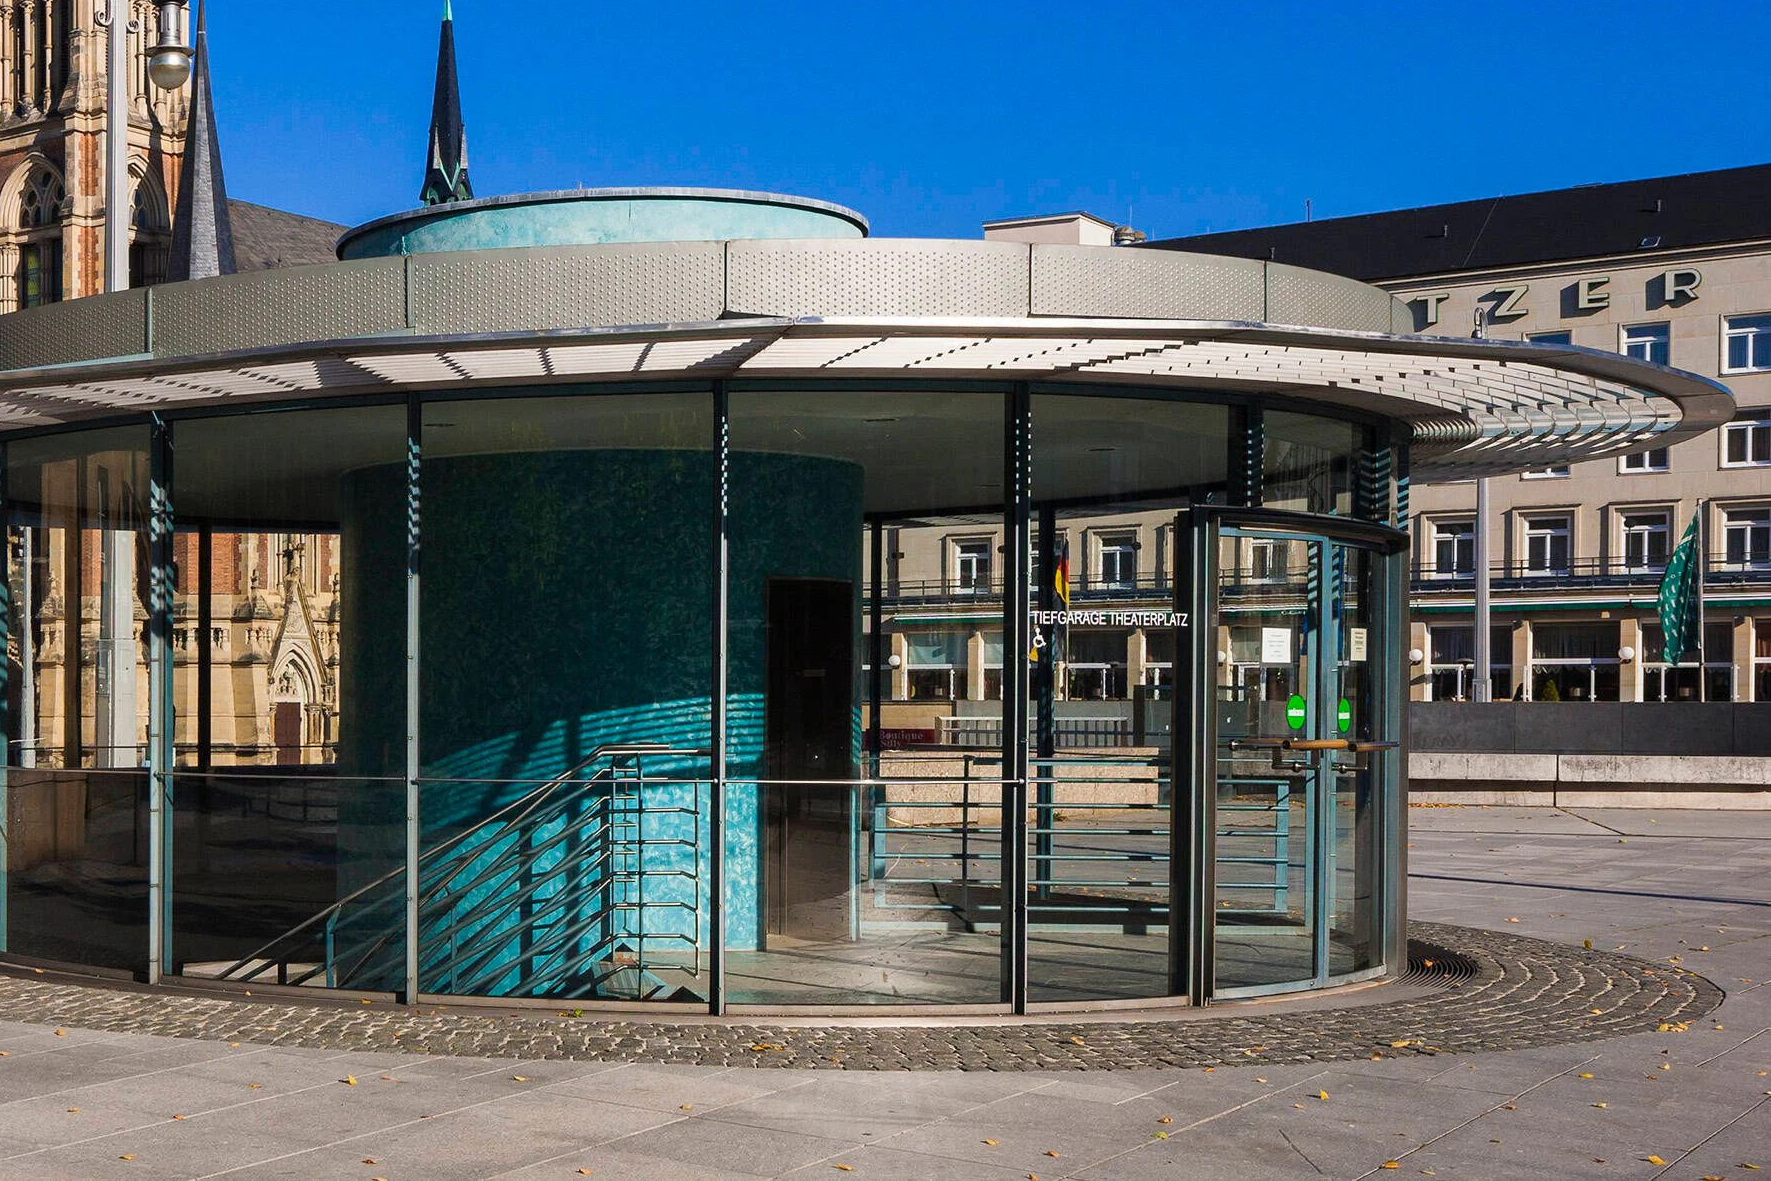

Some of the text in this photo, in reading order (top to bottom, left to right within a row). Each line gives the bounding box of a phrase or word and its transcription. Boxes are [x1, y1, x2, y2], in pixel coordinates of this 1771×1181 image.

[1032, 610, 1189, 627] TIEFGARAGE THEATERPLATZ
[879, 729, 925, 743] Boutique
